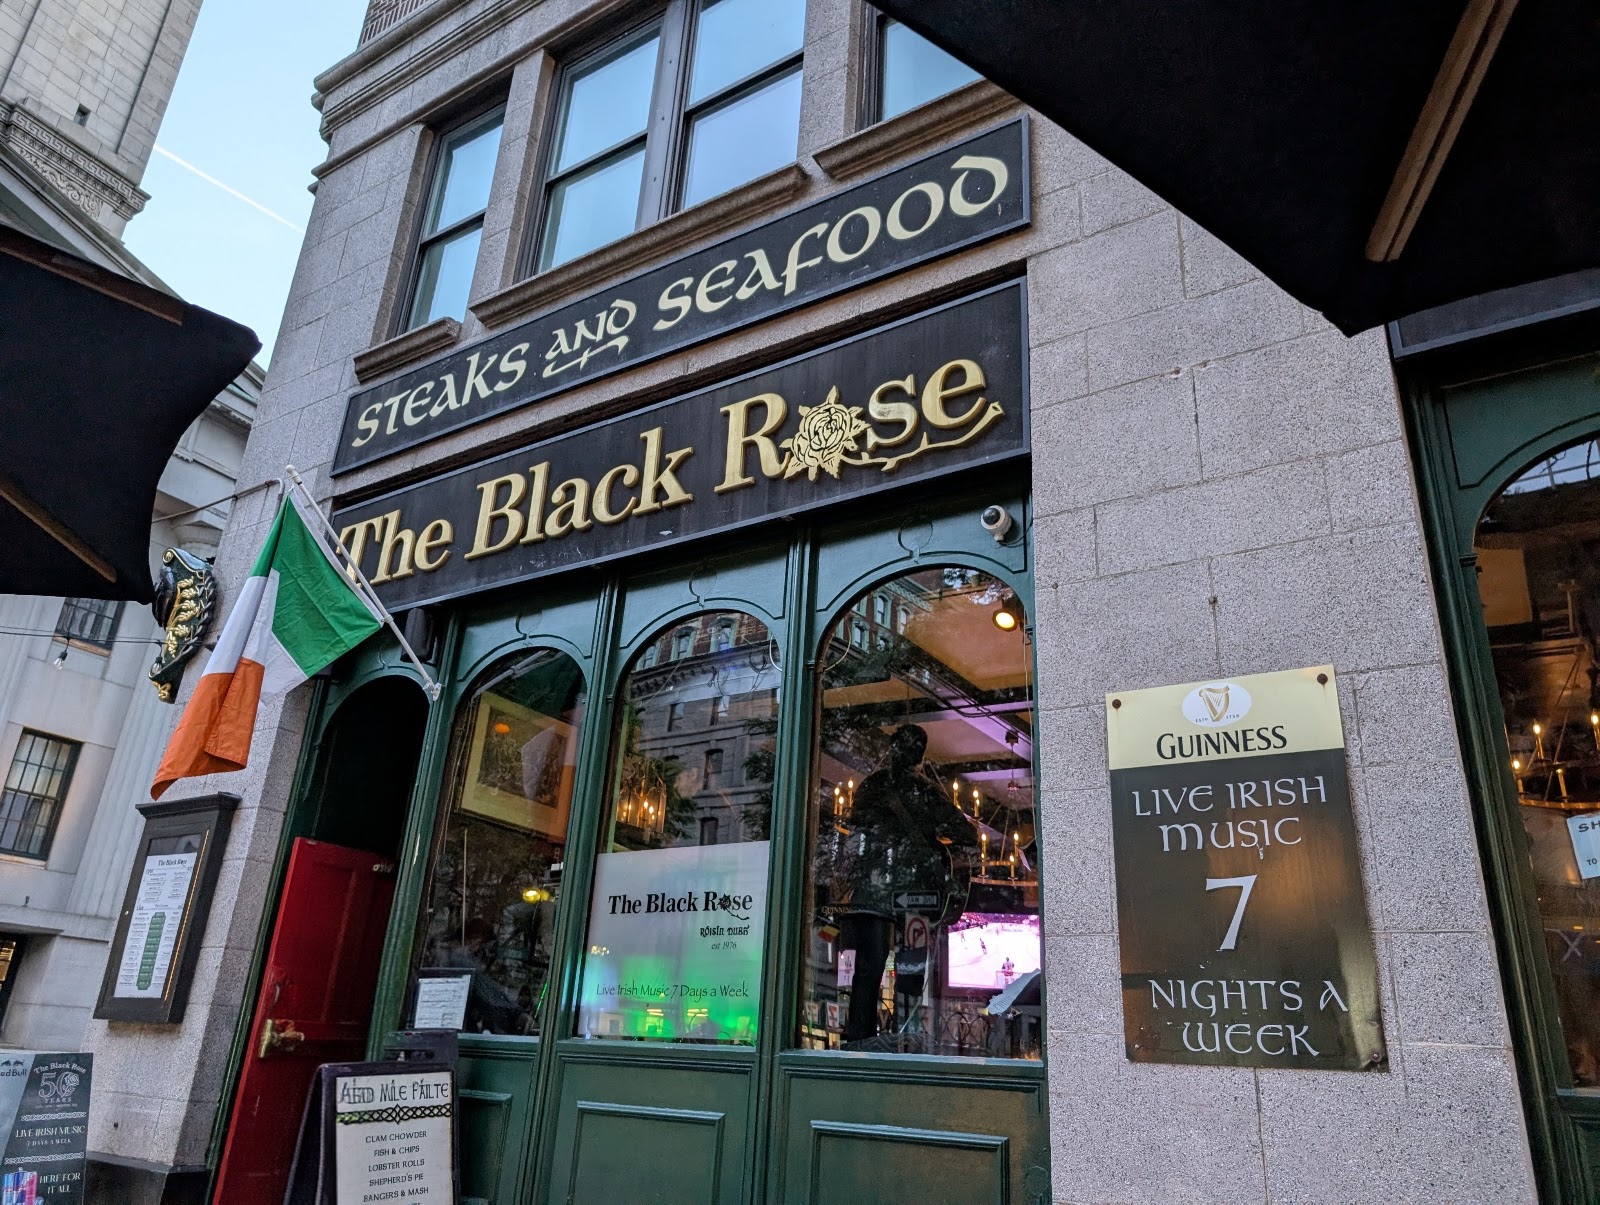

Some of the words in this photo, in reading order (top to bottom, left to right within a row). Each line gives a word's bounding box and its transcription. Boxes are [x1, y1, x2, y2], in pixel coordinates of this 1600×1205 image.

[351, 341, 531, 448] STEAKS
[653, 155, 1009, 332] SEAFOOD
[335, 508, 454, 588] The
[464, 426, 694, 561] Black
[1156, 725, 1288, 760] GUINNESS
[1132, 785, 1214, 816] LIVE
[1226, 775, 1328, 809] IRISH
[608, 894, 641, 914] The
[645, 891, 698, 913] Black
[1205, 874, 1258, 951] 7
[722, 941, 737, 950] 1976
[596, 984, 615, 995] Live
[617, 980, 638, 996] Irish
[640, 984, 669, 997] Music
[671, 984, 679, 999] 7
[680, 984, 707, 1003] Days
[710, 988, 717, 997] a
[719, 981, 749, 998] Week
[1148, 979, 1304, 1018] NIGHTS
[1319, 980, 1349, 1012] A
[1182, 1022, 1320, 1057] WEEK
[12, 1068, 27, 1077] Bull
[34, 1064, 49, 1075] The
[50, 1061, 71, 1070] Black
[71, 1062, 87, 1074] Rose
[16, 1129, 34, 1138] LIVE
[35, 1127, 58, 1137] IRISH
[59, 1125, 85, 1135] MUSIC
[365, 1134, 388, 1143] CLAM
[389, 1130, 428, 1141] CHOWDER
[373, 1148, 390, 1157] FISH
[391, 1147, 397, 1155] &
[399, 1145, 420, 1154] CHIPS
[368, 1161, 401, 1172] LOBSTER
[402, 1158, 425, 1168] ROLLS
[40, 1174, 59, 1184] HERE
[62, 1172, 81, 1182] FOR
[369, 1172, 413, 1187] SHEPHERD'S
[414, 1172, 424, 1181] PIE
[47, 1185, 56, 1194] IT
[59, 1184, 71, 1193] ALL
[363, 1190, 399, 1203] BANGERS
[400, 1189, 406, 1197] &
[407, 1186, 429, 1197] MASH
